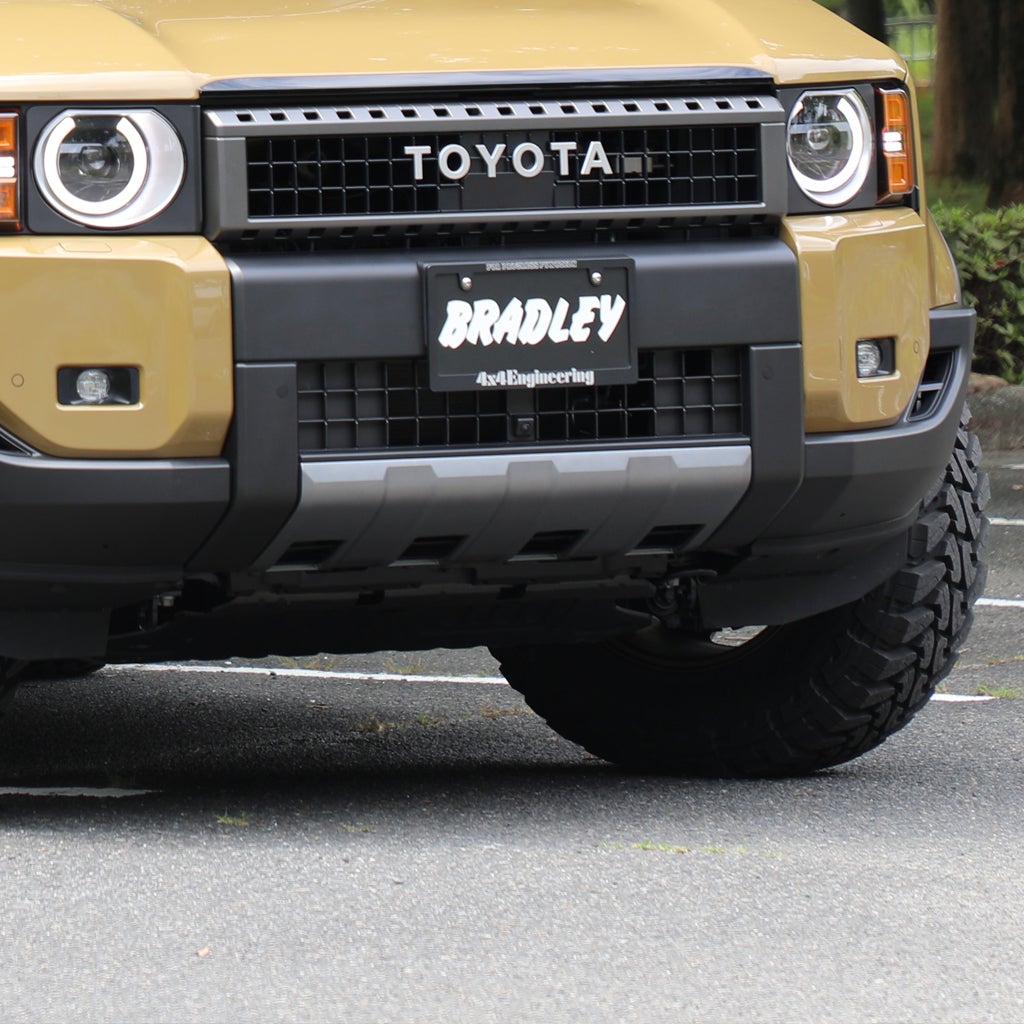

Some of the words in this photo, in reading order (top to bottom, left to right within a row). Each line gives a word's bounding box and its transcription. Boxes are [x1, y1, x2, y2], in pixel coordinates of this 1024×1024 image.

[404, 141, 613, 181] TOYOTA
[438, 294, 626, 349] BRADLEY
[476, 367, 595, 388] 4x4Engineering
